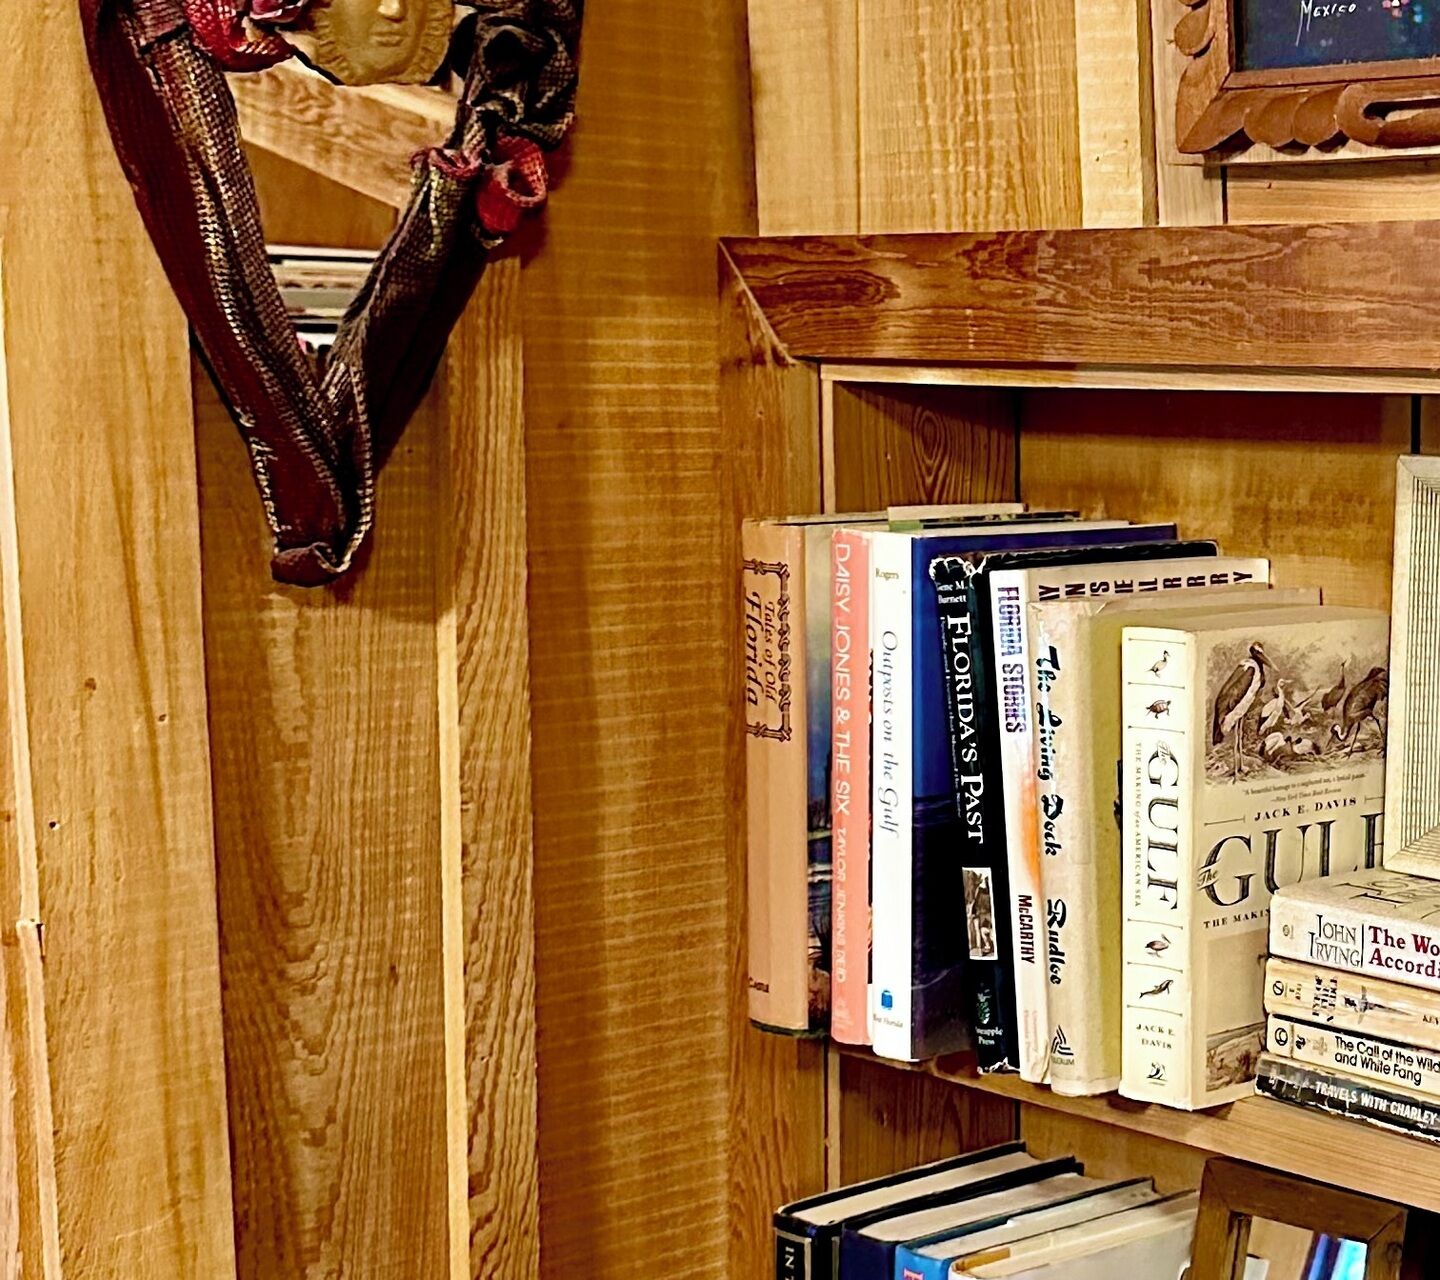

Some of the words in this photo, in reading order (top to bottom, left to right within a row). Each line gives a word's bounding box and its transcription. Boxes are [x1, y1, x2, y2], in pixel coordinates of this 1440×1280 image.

[834, 543, 851, 613] DAISY
[834, 625, 851, 701] JONES
[881, 630, 899, 716] Outposts
[947, 613, 979, 763] FLORIDA'S
[835, 708, 850, 721] &
[883, 719, 893, 743] on
[835, 729, 851, 770] THE
[883, 751, 899, 780] the
[835, 782, 850, 816] SIX
[879, 786, 900, 836] Gulf
[960, 773, 985, 844] PAST
[1254, 808, 1291, 822] JACK
[1297, 805, 1309, 815] E.
[1314, 796, 1358, 812] DAVIS
[1018, 894, 1036, 964] McCARTHY
[1315, 913, 1357, 943] JOHN
[1368, 925, 1407, 950] The
[1307, 931, 1361, 968] IRVING
[1334, 1051, 1358, 1067] and
[1360, 1055, 1392, 1076] White
[1392, 1064, 1423, 1087] Fang
[784, 1245, 795, 1269] IN
